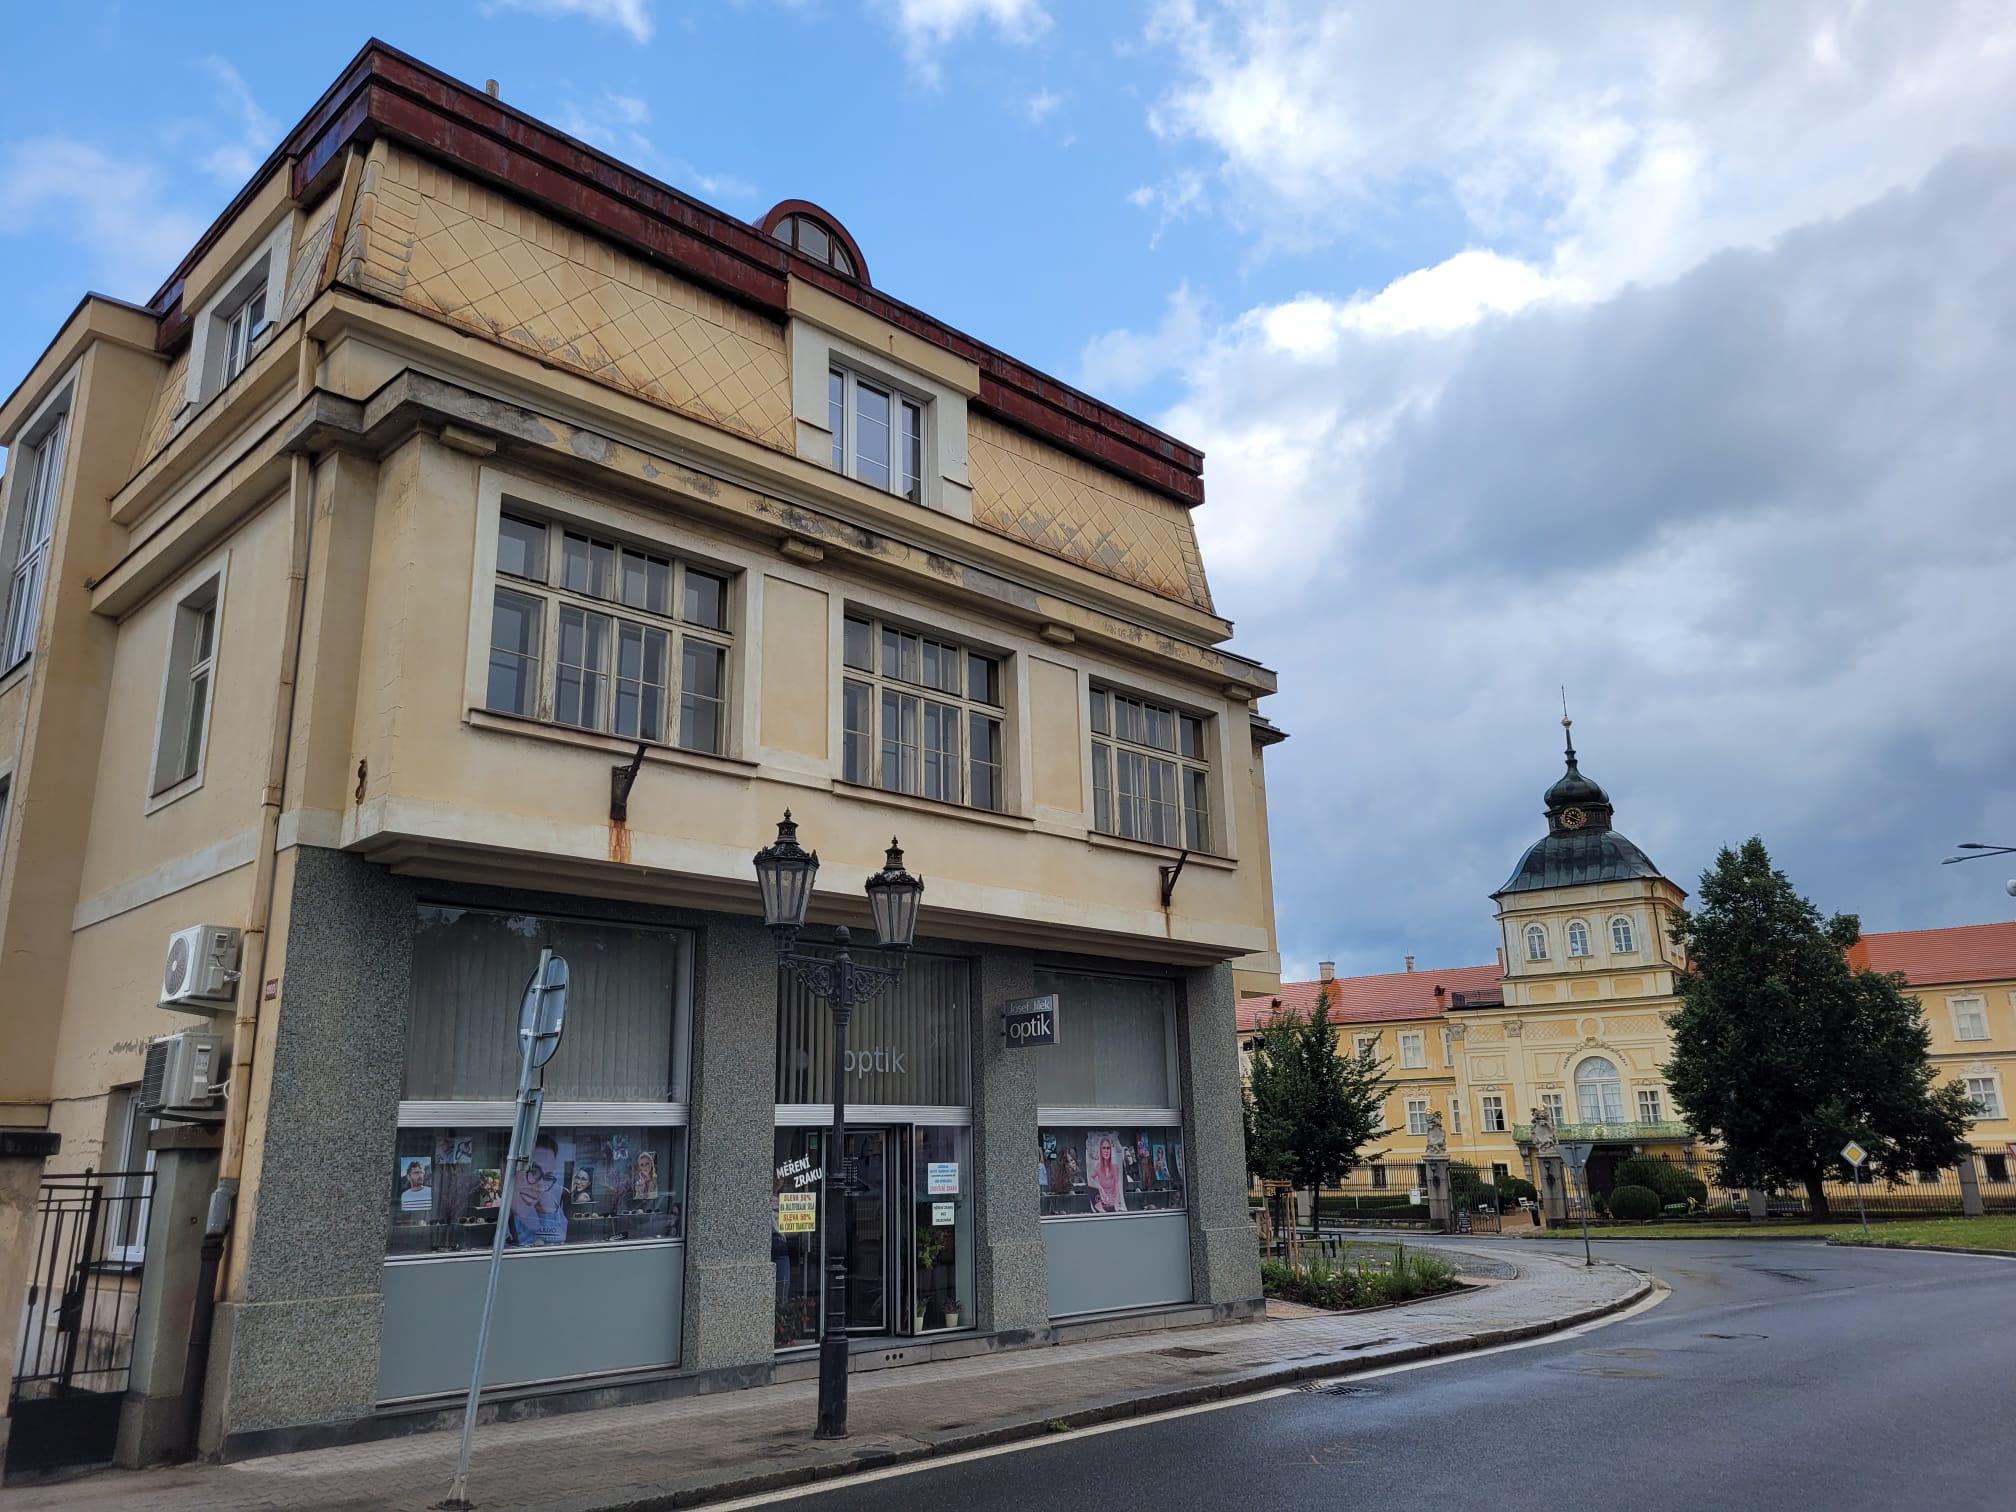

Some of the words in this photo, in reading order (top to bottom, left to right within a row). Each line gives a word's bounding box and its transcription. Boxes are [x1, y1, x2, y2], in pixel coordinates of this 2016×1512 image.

[1010, 1013, 1051, 1044] optik
[844, 1045, 906, 1079] optik
[776, 1153, 811, 1180] MĚŘENÍ
[793, 1167, 822, 1188] ZRAKU
[783, 1213, 799, 1221] SLEVA
